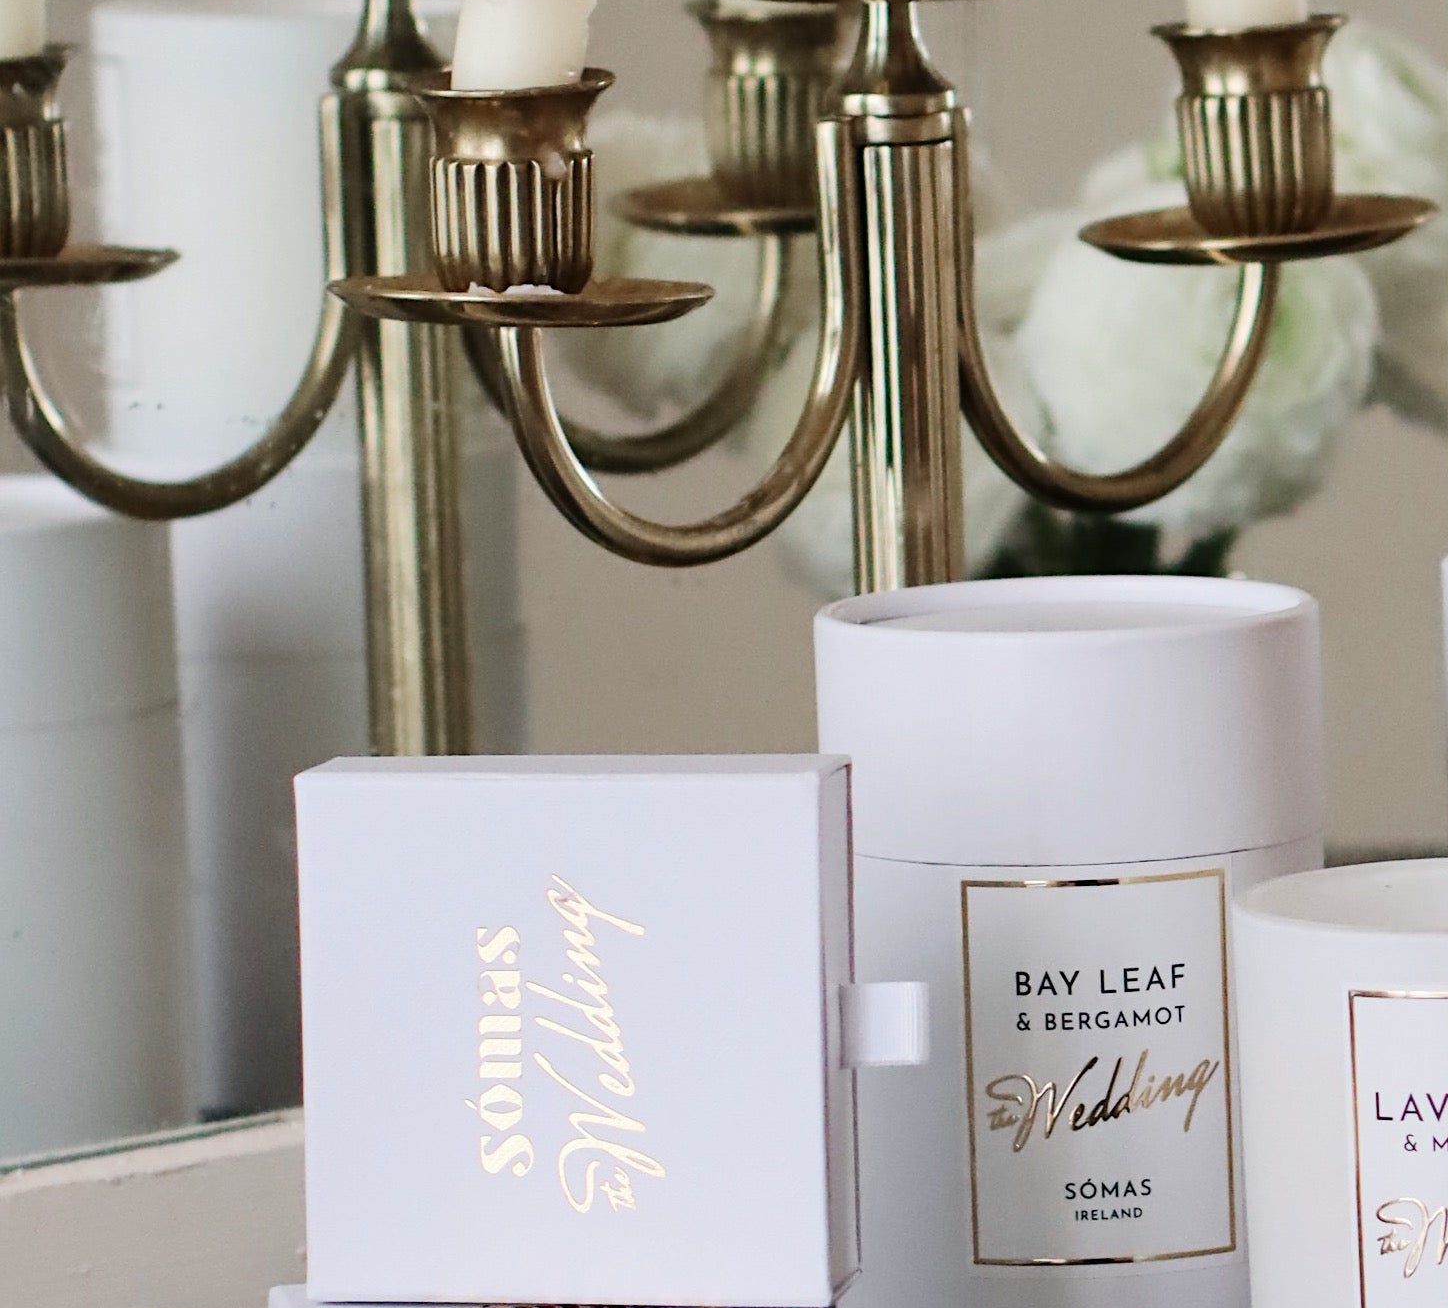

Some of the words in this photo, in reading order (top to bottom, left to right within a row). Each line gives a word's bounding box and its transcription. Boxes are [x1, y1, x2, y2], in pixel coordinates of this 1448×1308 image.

[1014, 969, 1080, 997] BAY
[1099, 962, 1186, 995] LEAF
[1015, 1011, 1032, 1032] &
[1044, 1004, 1187, 1032] BERGAMOT
[525, 872, 666, 1214] Wedding
[985, 1048, 1220, 1153] Wedding
[1403, 1133, 1418, 1153] &
[1064, 1177, 1153, 1201] SÓMAS
[1074, 1206, 1144, 1222] IRELAND
